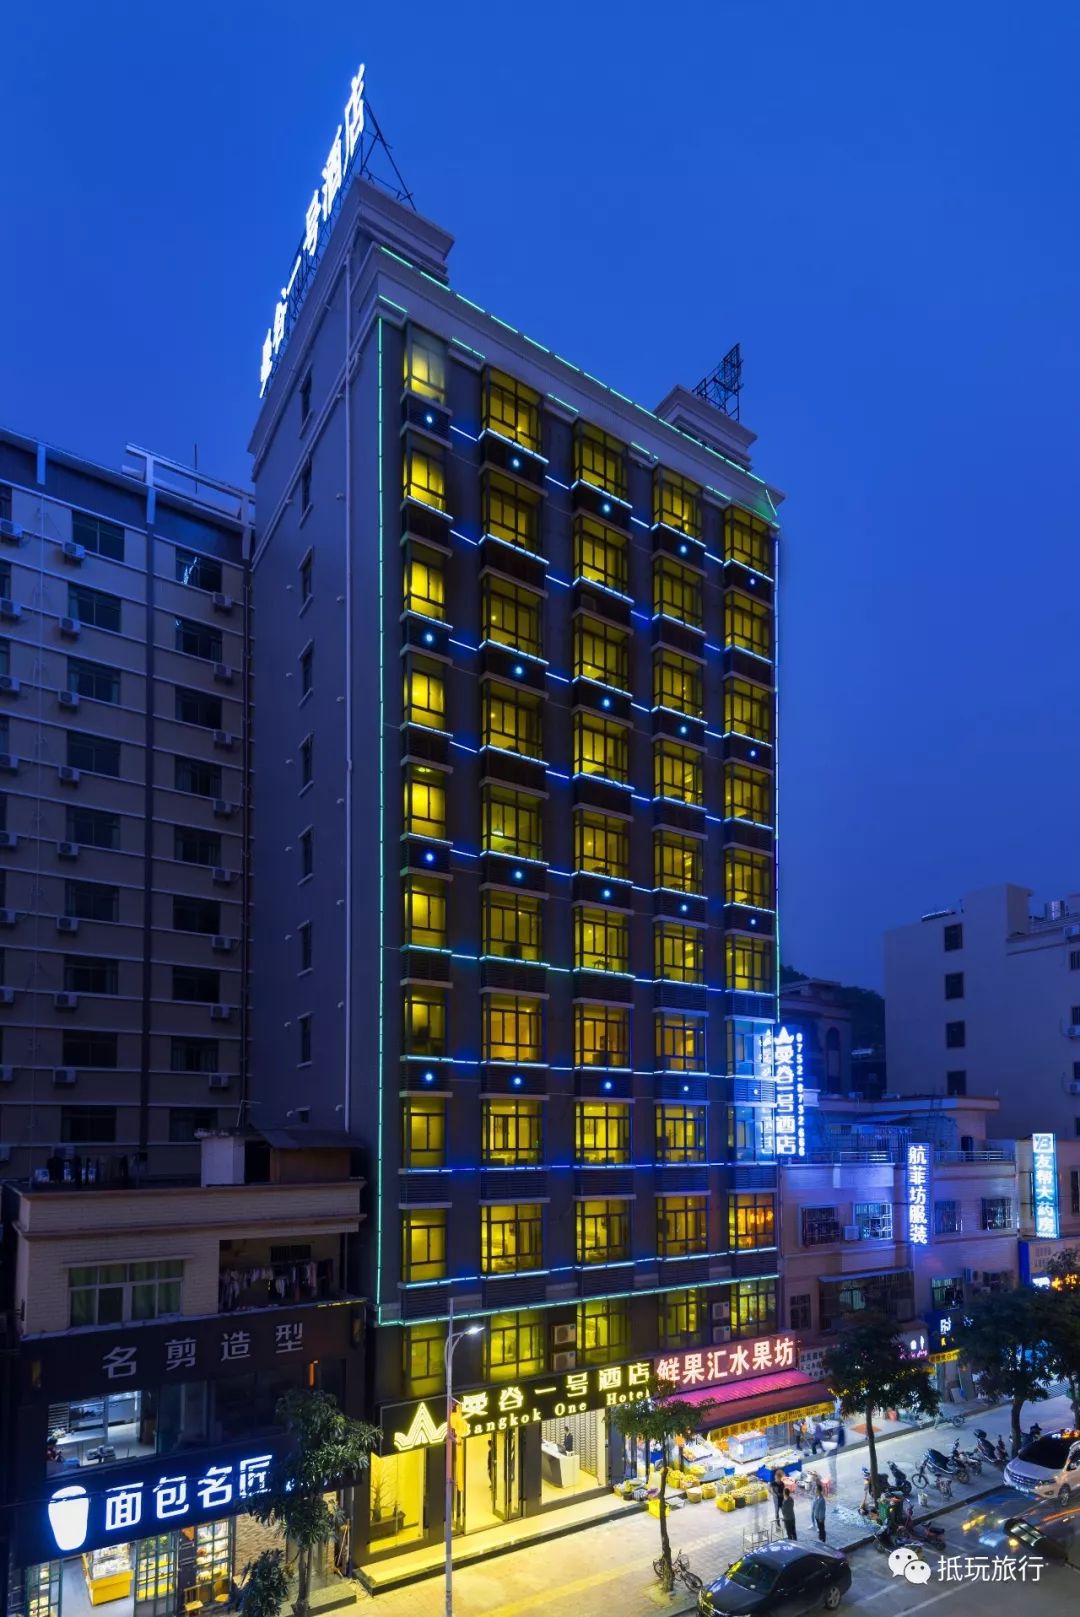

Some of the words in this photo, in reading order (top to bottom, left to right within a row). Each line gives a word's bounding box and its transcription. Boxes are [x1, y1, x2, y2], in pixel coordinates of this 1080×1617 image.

[774, 1045, 796, 1155] 曼谷一号酒店
[908, 1145, 928, 1245] 航菲坊服装
[102, 1321, 304, 1380] 名剪造型
[656, 1337, 794, 1388] 鲜果汇水果坊
[462, 1362, 650, 1419] 曼谷一号酒店
[554, 1401, 588, 1416] One
[606, 1387, 650, 1406] Hotel
[105, 1454, 274, 1532] 面包名匠
